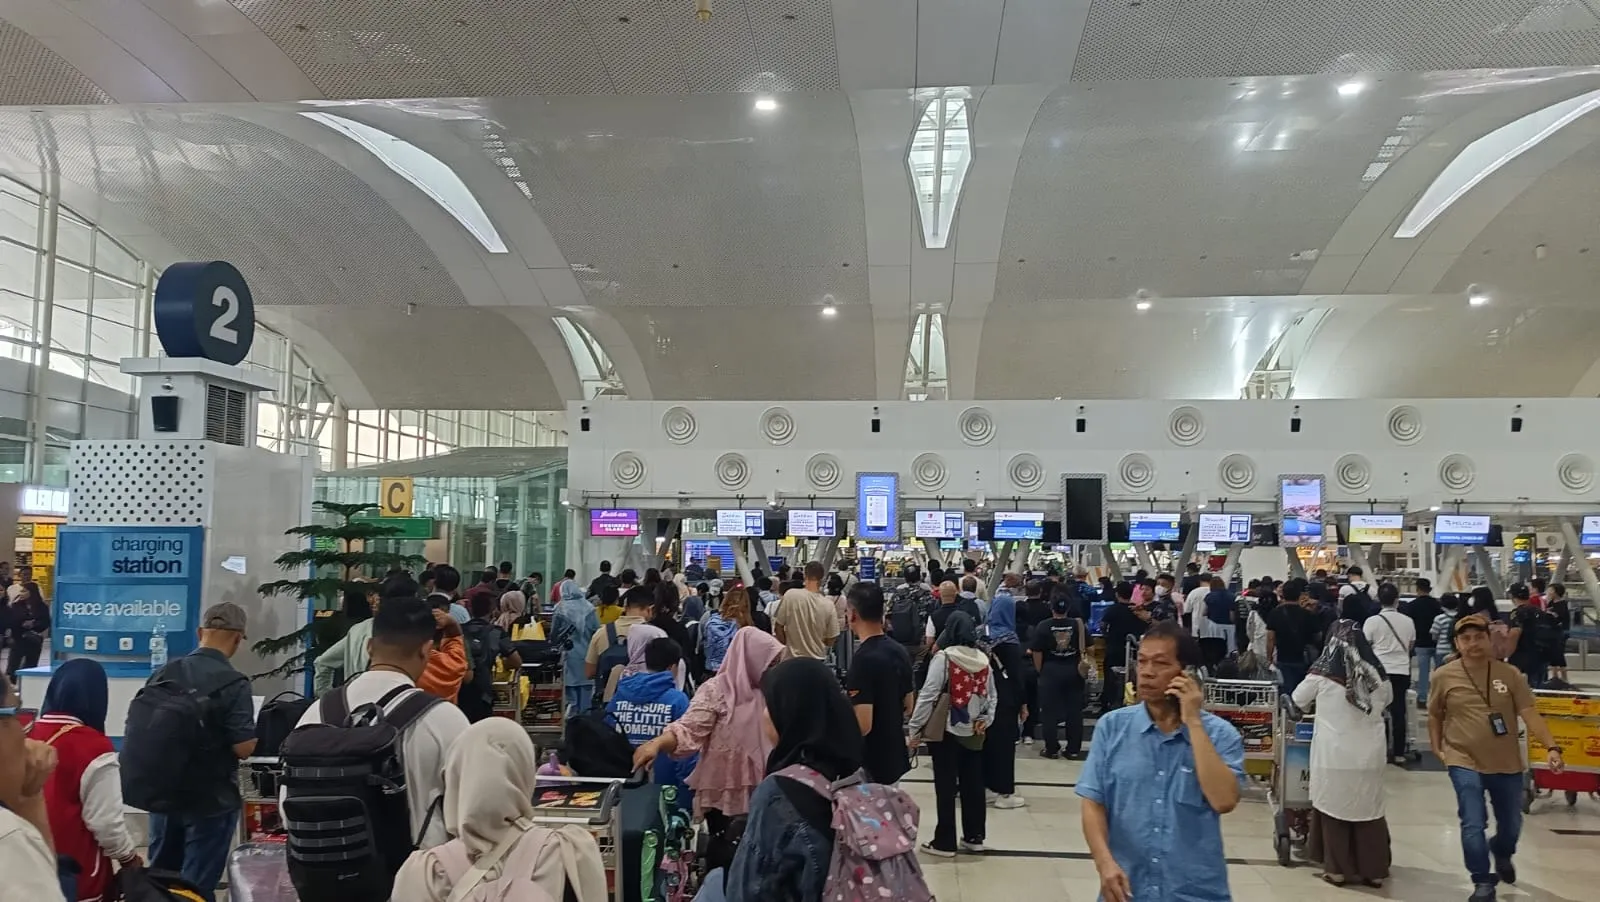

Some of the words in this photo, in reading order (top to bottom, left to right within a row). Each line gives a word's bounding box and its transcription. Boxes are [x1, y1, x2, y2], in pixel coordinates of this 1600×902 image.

[209, 285, 240, 344] 2
[386, 482, 405, 514] C
[111, 536, 184, 556] charging
[111, 556, 183, 574] station
[62, 601, 102, 619] space
[104, 599, 182, 617] available
[615, 700, 673, 715] TREASURE
[633, 713, 672, 725] LITTLE
[615, 723, 664, 736] MOMENT
